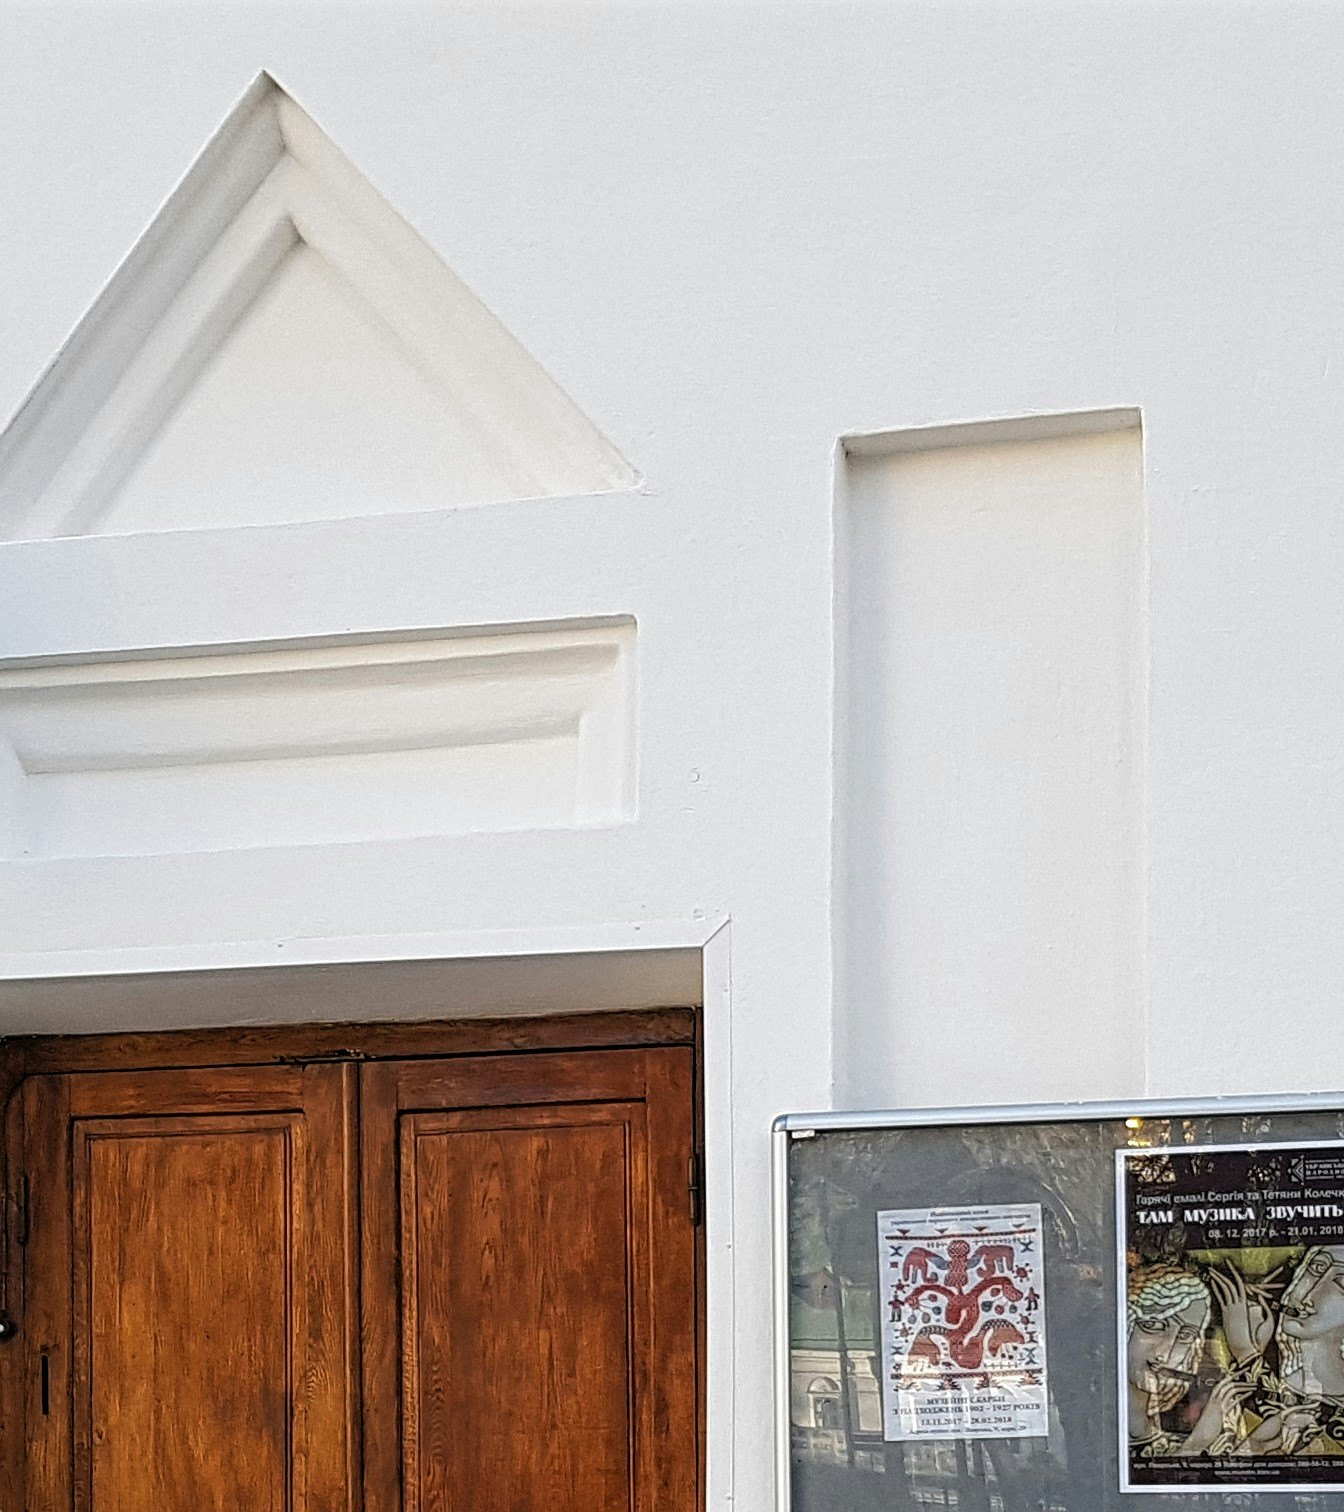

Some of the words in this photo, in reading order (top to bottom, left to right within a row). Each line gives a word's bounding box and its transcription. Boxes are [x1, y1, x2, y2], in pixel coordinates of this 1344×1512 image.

[1137, 1210, 1173, 1224] ТАМ
[1184, 1207, 1255, 1224] МУЗИКА
[1266, 1205, 1343, 1220] ЗВУЧИТЬ
[1243, 1228, 1266, 1237] 2017
